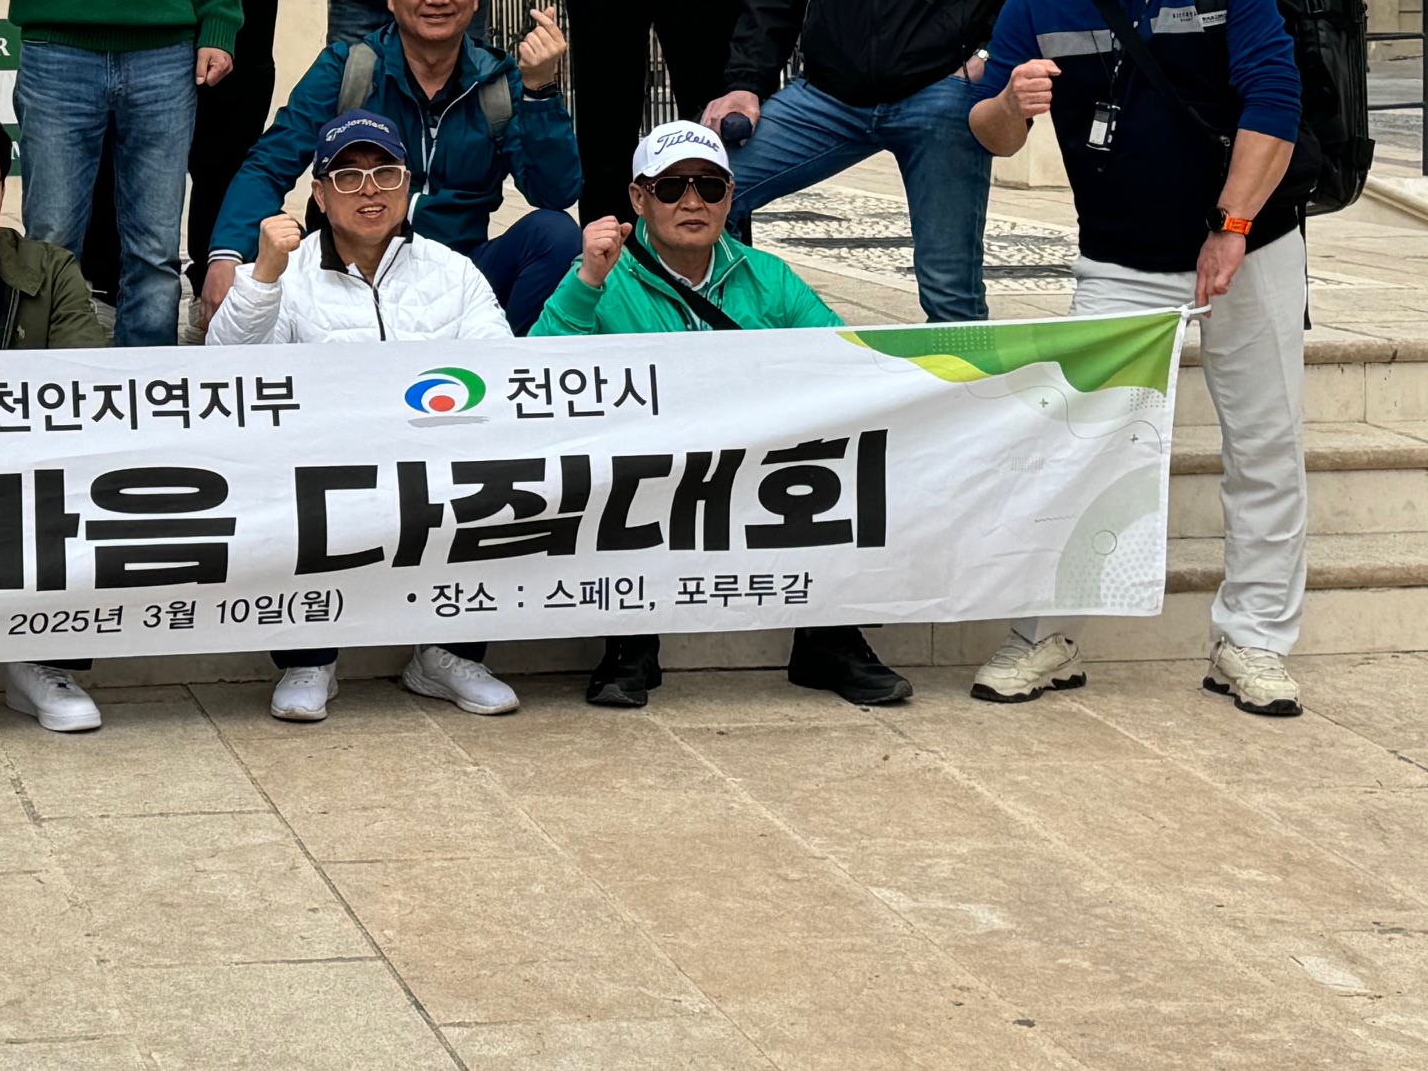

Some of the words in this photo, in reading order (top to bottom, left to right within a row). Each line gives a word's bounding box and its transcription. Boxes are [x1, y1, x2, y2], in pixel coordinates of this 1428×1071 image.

[325, 118, 390, 142] TaylorMade
[506, 363, 659, 419] 천안시
[293, 428, 889, 579] 다짐대회
[7, 604, 124, 636] 2025년
[143, 600, 197, 630] 3월
[216, 588, 345, 626] 10일(월)
[430, 580, 498, 618] 장소
[543, 575, 657, 612] 스페인,
[674, 571, 813, 606] 포루투갈
